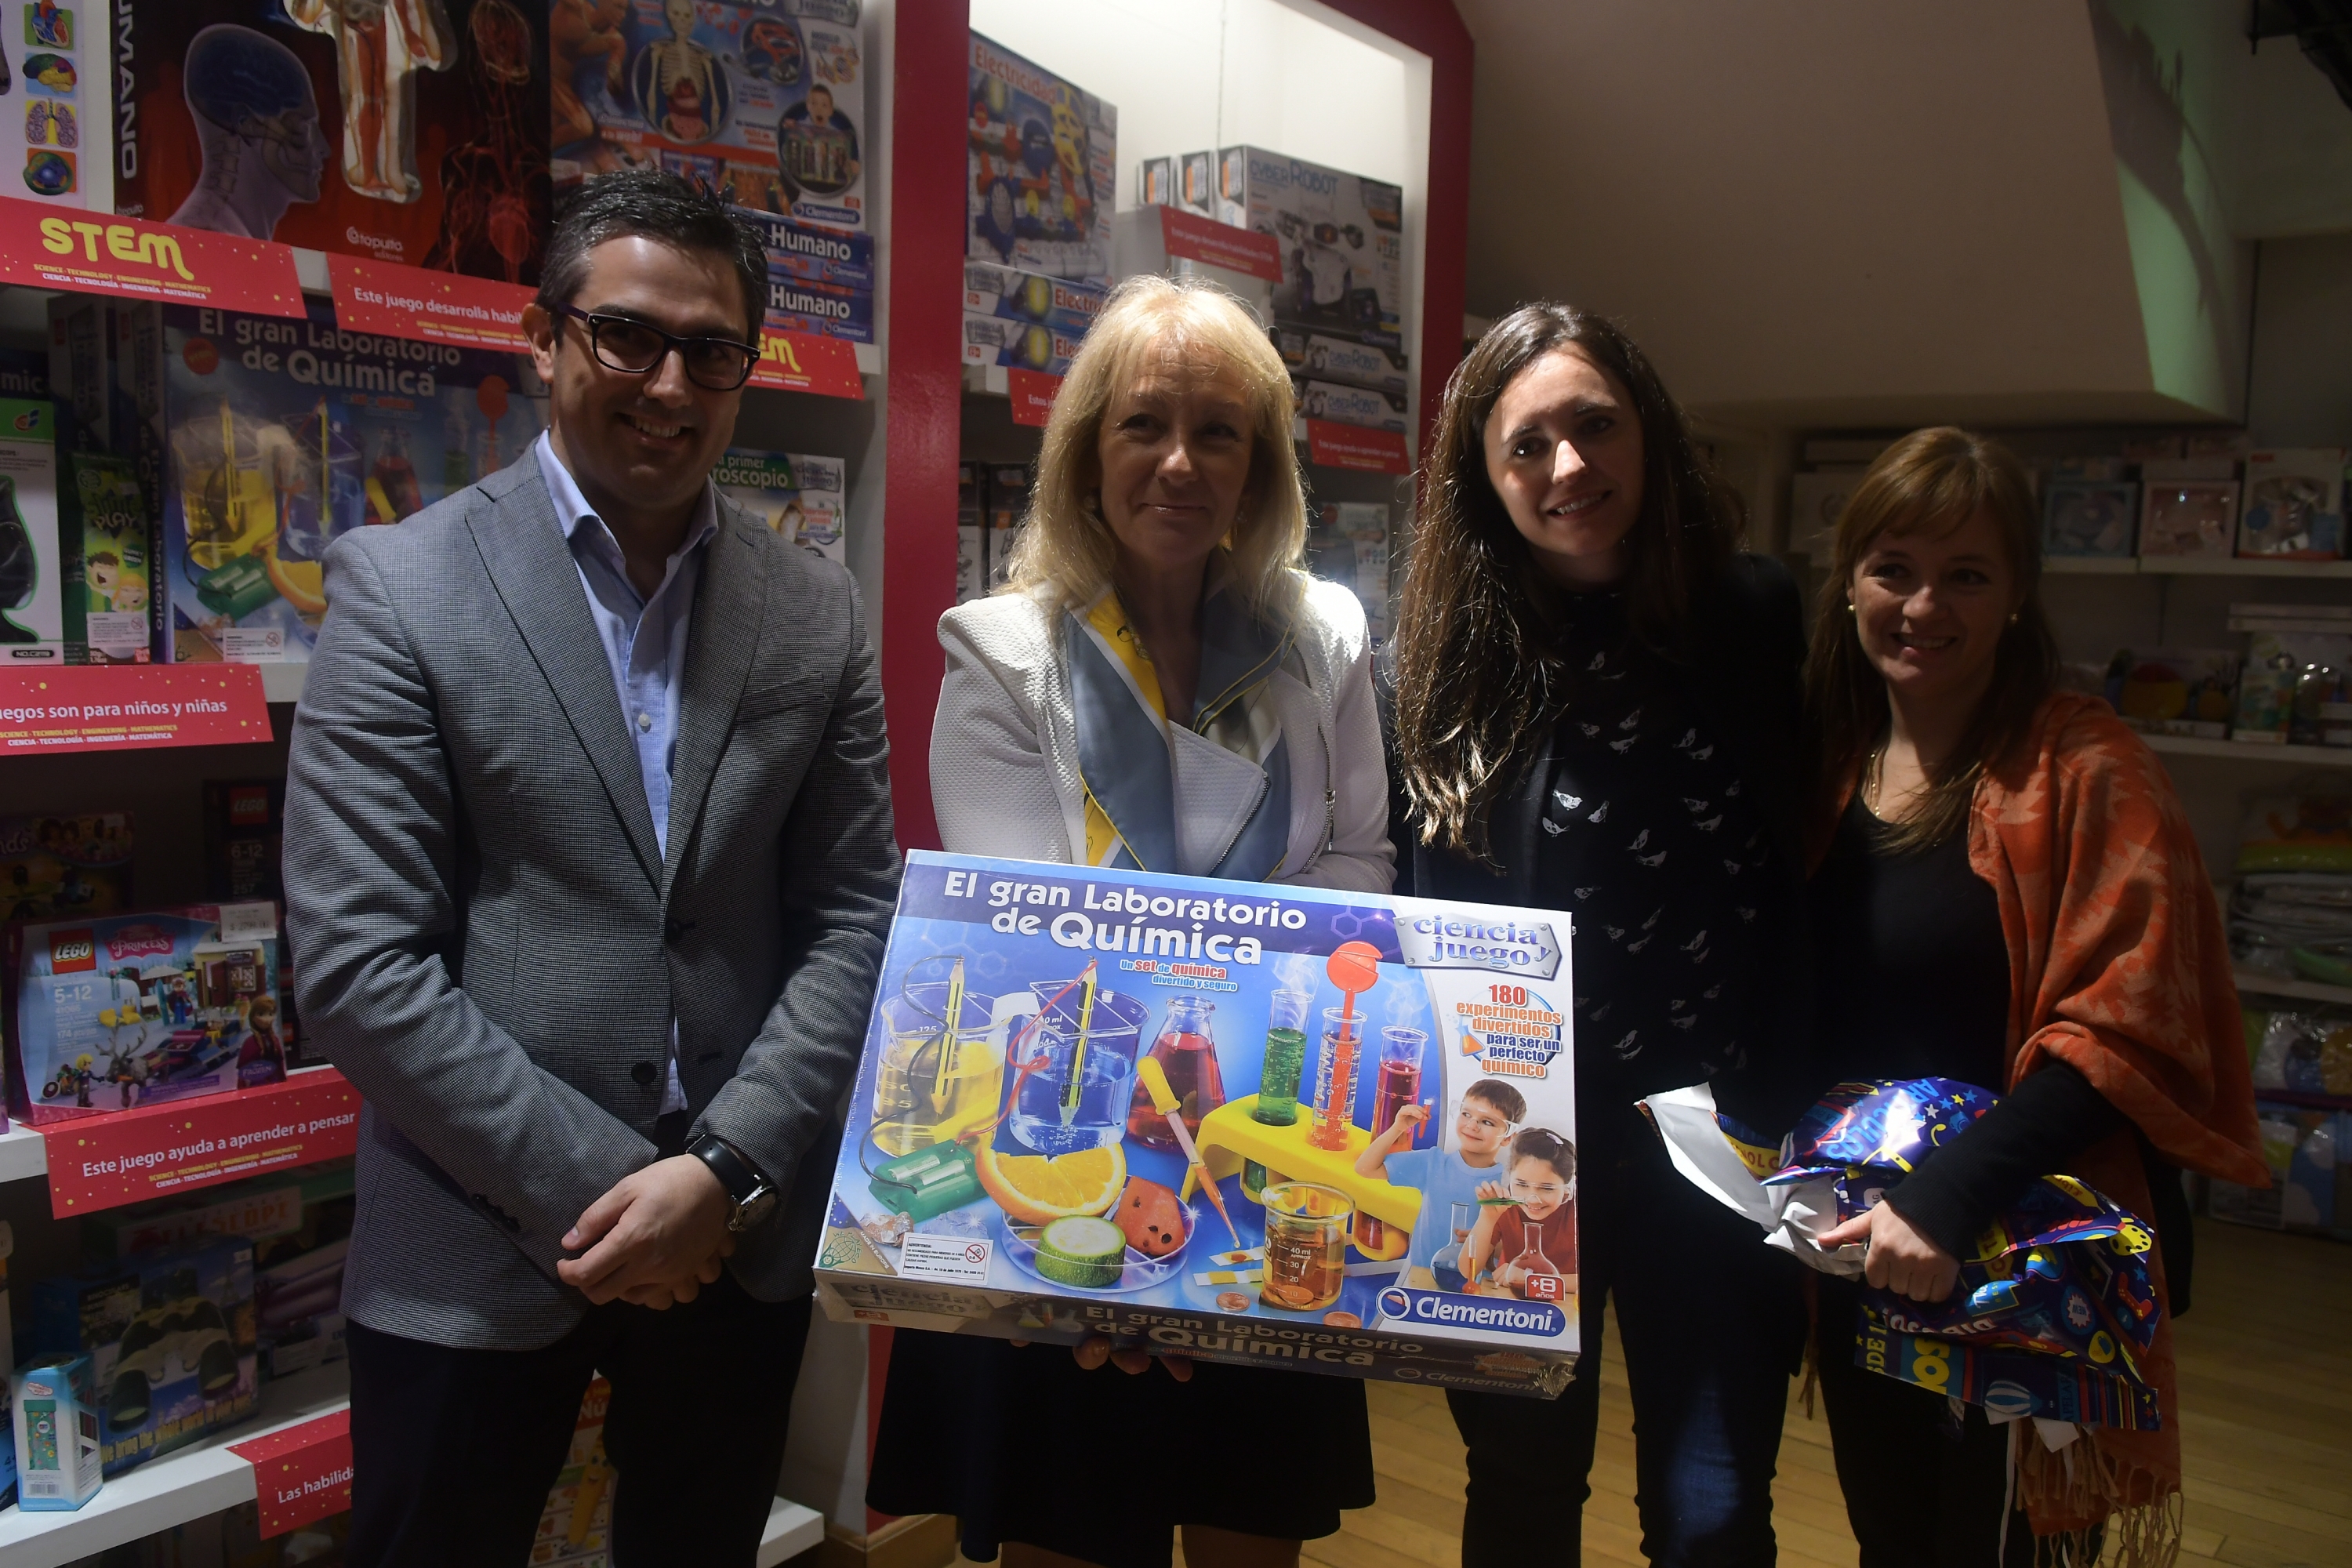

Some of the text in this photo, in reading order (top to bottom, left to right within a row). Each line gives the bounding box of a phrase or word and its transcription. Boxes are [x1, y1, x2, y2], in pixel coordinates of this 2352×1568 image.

[806, 207, 856, 223] Clementoni
[39, 217, 194, 281] STEM
[771, 223, 851, 261] Humano
[34, 263, 63, 273] SCIENCE
[67, 268, 113, 280] TECHNOLOGY
[42, 273, 71, 282] CIENCIA
[74, 277, 118, 289] TECNOLOGÍA
[354, 287, 383, 304] Este
[384, 292, 424, 313] juego
[426, 299, 488, 321] desarrolla
[770, 285, 851, 318] Humano
[199, 308, 223, 336] El
[235, 318, 296, 345] gran
[307, 322, 461, 366] Laboratorio
[242, 345, 436, 397] de Química
[728, 456, 764, 470] primer
[152, 519, 165, 632] Laboratorio
[49, 706, 79, 719] son
[83, 703, 121, 721] para
[125, 699, 169, 716] niños
[172, 703, 181, 717] y
[185, 699, 227, 714] niñas
[7, 738, 36, 746] CIENCIA
[234, 799, 264, 811] LEGO
[944, 871, 1307, 931] El gran Laboratorio
[992, 906, 1263, 965] de Química
[1413, 915, 1541, 945] ciencia
[53, 941, 93, 961] LEGO
[111, 937, 169, 954] PRINCESS
[1428, 936, 1530, 968] juego
[1120, 960, 1228, 978] Un set de química
[54, 985, 93, 1004] 5-12
[1152, 975, 1238, 992] divertido y seguro
[1488, 984, 1526, 1006] 180
[1456, 1000, 1563, 1024] experimentos
[1472, 1017, 1551, 1038] divertidos
[1486, 1033, 1561, 1051] para ser un
[1489, 1045, 1546, 1062] perfecto
[1481, 1058, 1545, 1078] químico
[82, 1112, 355, 1178] Este juego ayuda a aprender a pensar
[860, 1231, 872, 1246] MADE
[873, 1249, 891, 1269] EUROPE
[1531, 1278, 1556, 1293] +8
[1416, 1296, 1553, 1332] Clementoni
[1086, 1305, 1424, 1353] El gran Laboratorio
[1094, 1322, 1374, 1367] de Química
[1425, 1372, 1537, 1392] Clementoni
[278, 1486, 302, 1504] Las
